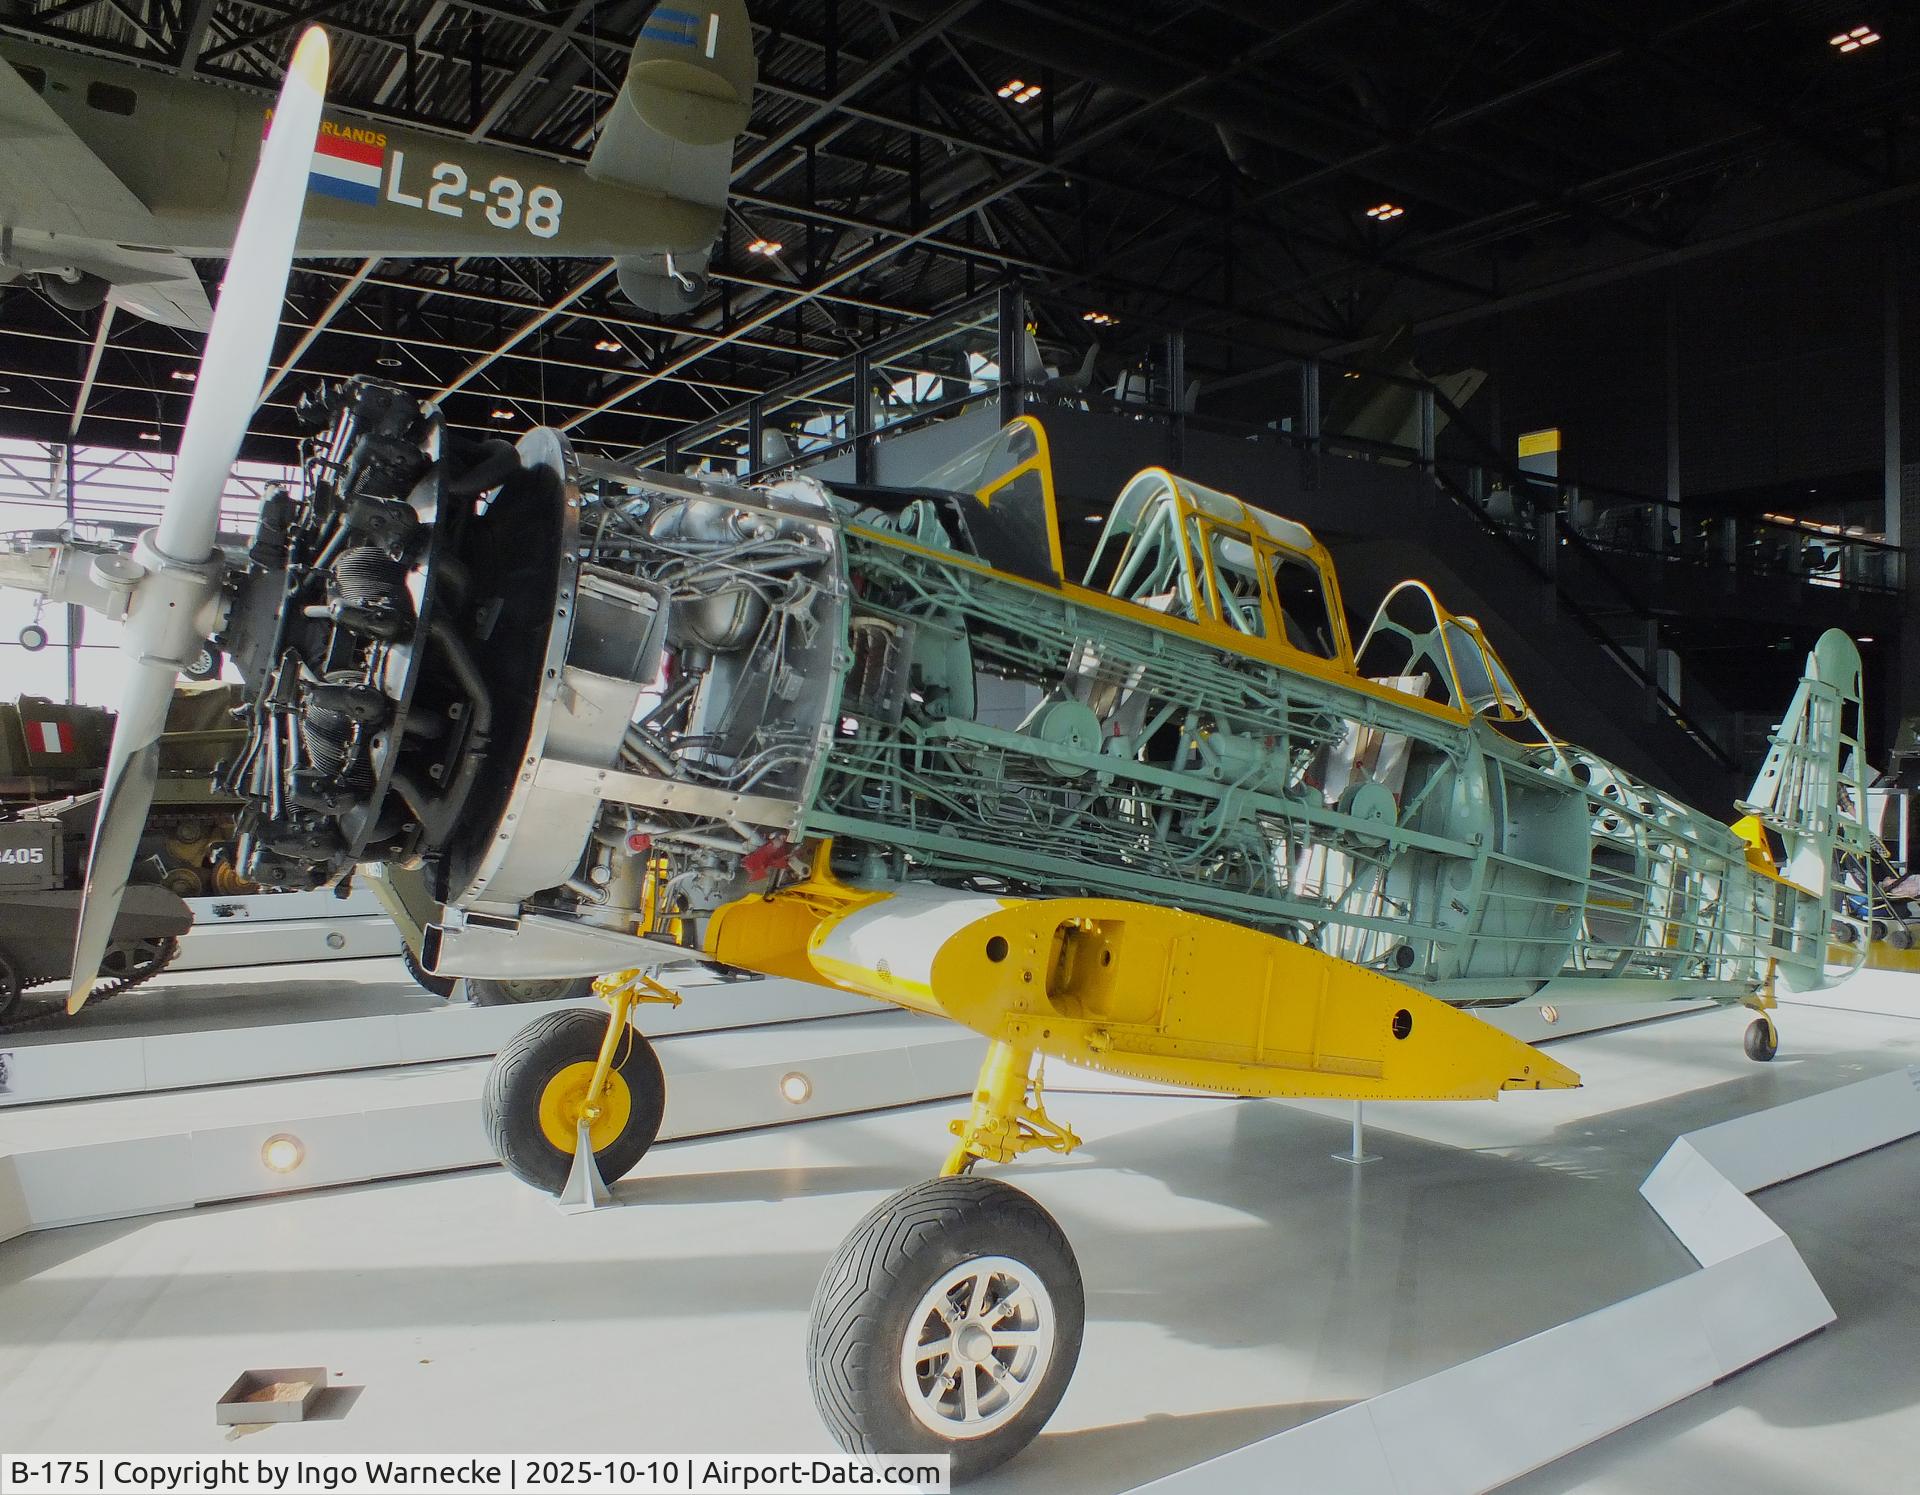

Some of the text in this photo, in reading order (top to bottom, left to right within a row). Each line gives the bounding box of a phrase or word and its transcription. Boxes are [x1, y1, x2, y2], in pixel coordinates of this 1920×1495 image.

[263, 107, 387, 148] NRLANDS
[387, 150, 563, 239] L2-38
[0, 847, 44, 865] 405
